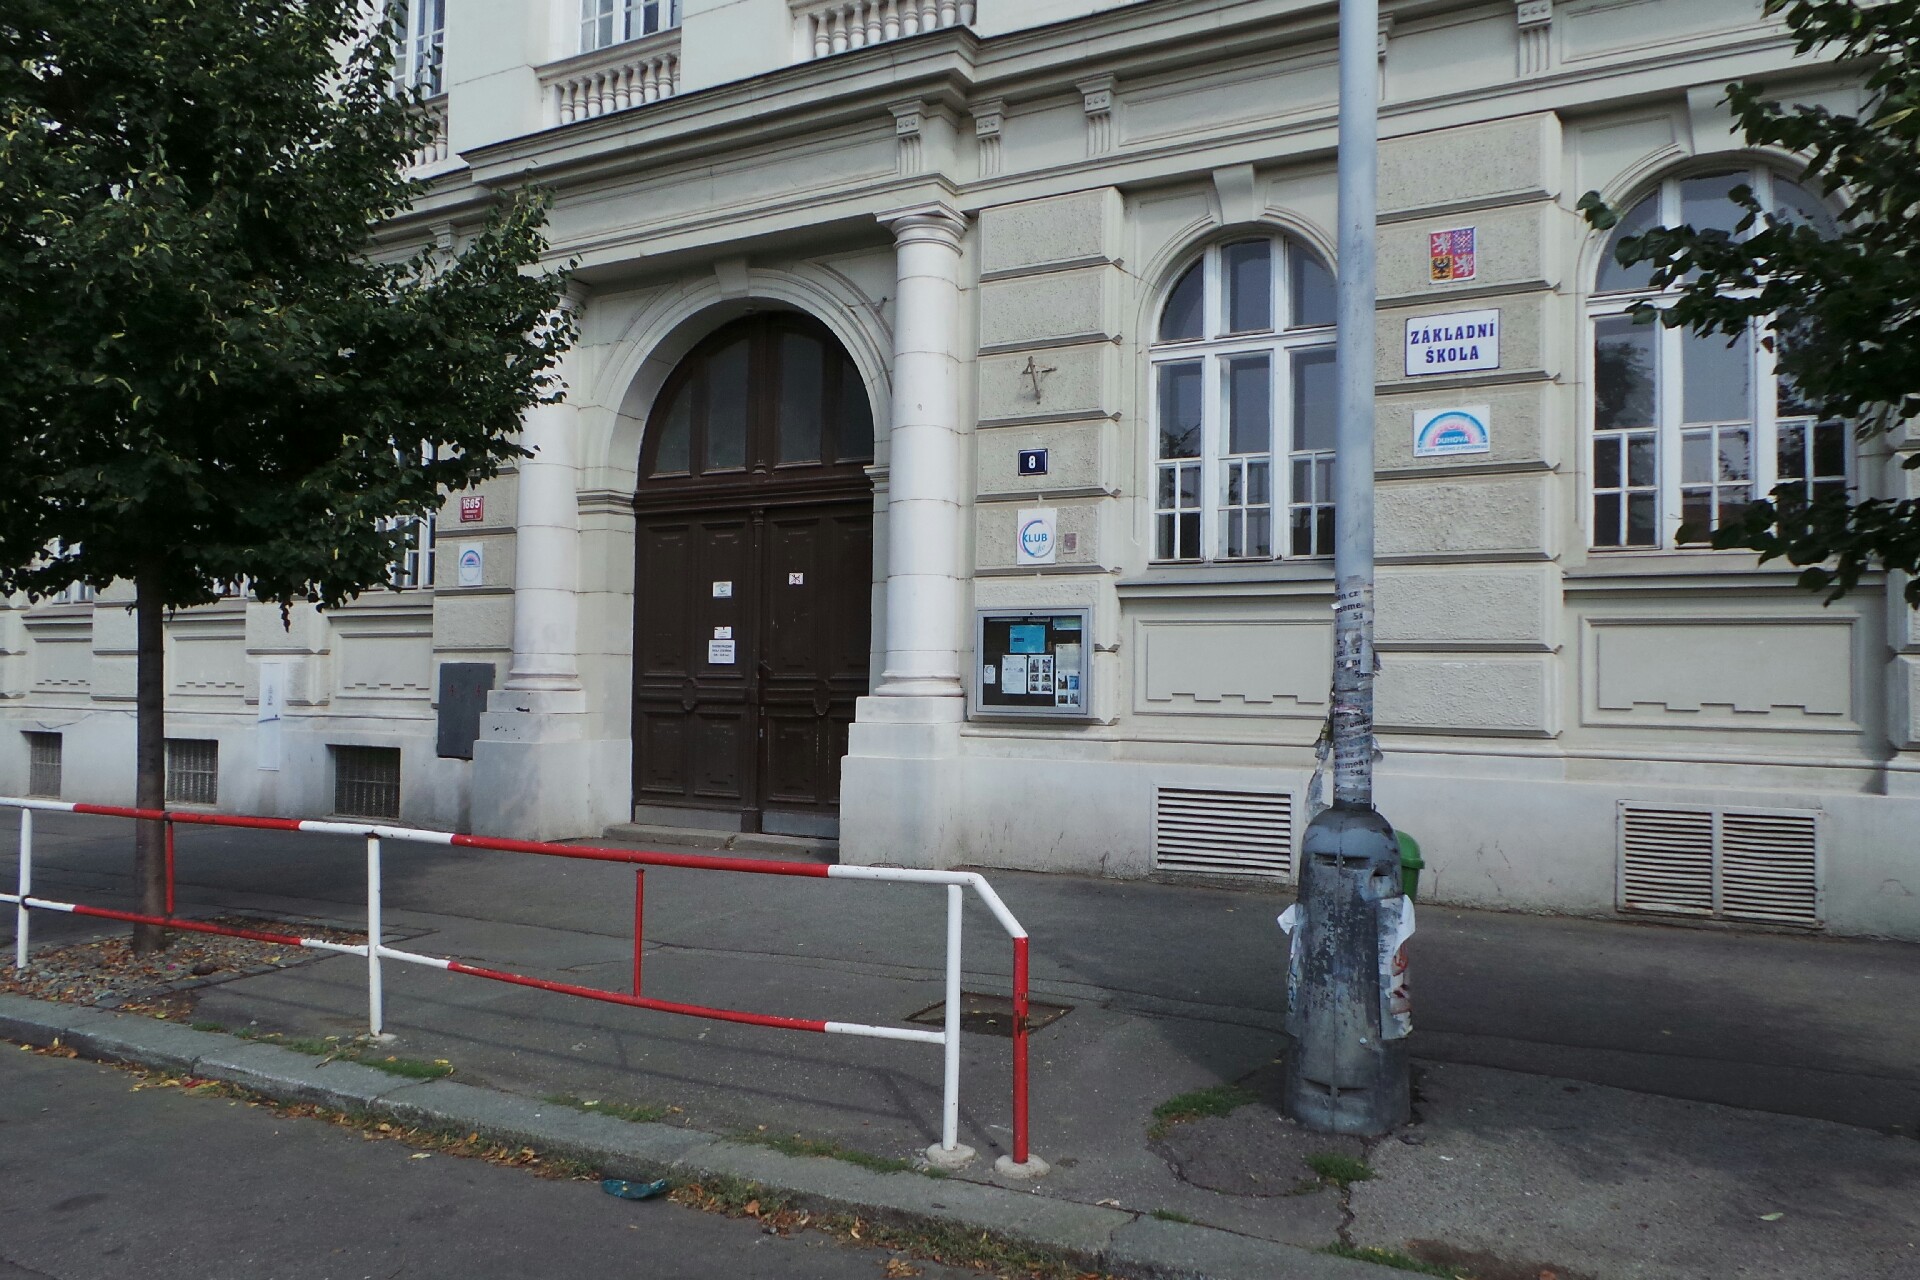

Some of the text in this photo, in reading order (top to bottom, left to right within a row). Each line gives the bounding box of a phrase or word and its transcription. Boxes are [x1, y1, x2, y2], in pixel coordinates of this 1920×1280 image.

[1410, 318, 1494, 345] ZÁKLADNÍ
[1425, 345, 1479, 364] ŠKOLA
[1028, 455, 1036, 469] 8
[1023, 533, 1048, 542] KLUB
